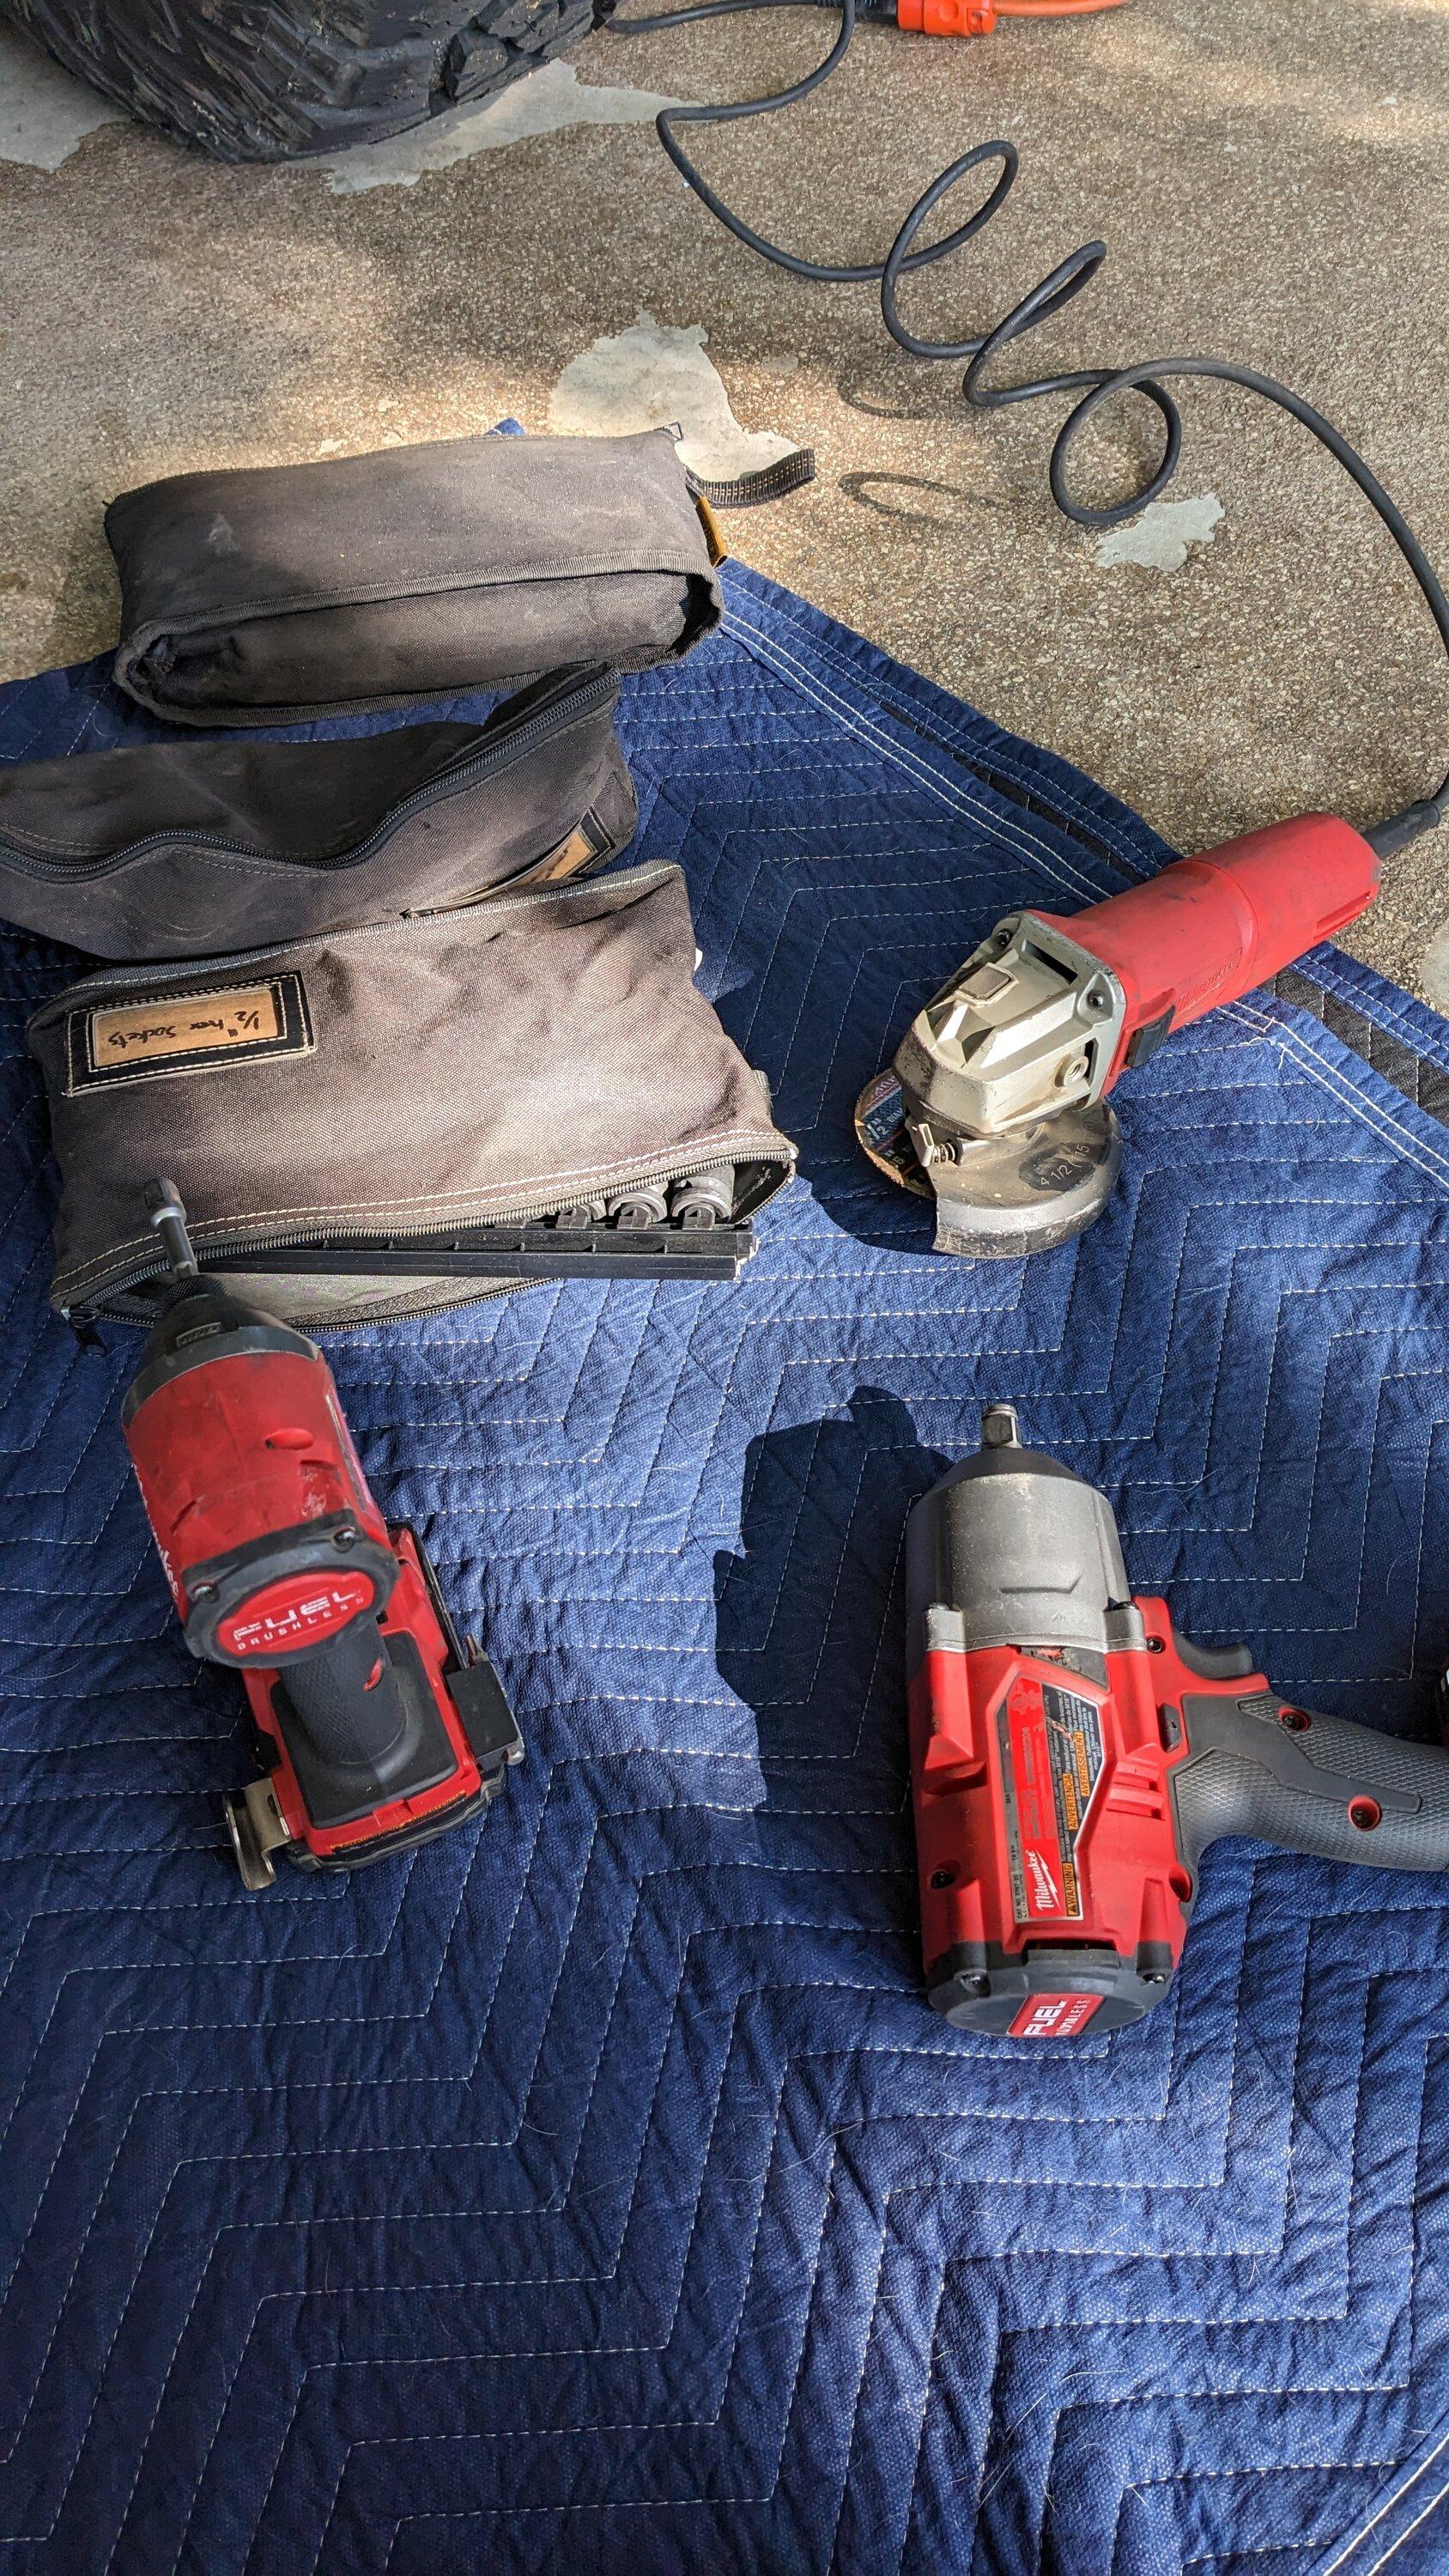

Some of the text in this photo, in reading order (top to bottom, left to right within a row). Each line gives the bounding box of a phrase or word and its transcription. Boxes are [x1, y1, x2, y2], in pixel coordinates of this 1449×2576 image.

[1040, 1177, 1050, 1186] 4
[1051, 1164, 1073, 1180] 1/2
[233, 1591, 361, 1641] FUEL
[1076, 1732, 1089, 1795] AVERTISSEMENT
[1064, 1775, 1077, 1828] ADVERTENCIA
[1026, 1850, 1055, 1912] Milwaukee
[1064, 1865, 1076, 1905] WARNING
[1023, 1999, 1067, 2035] FUEL
